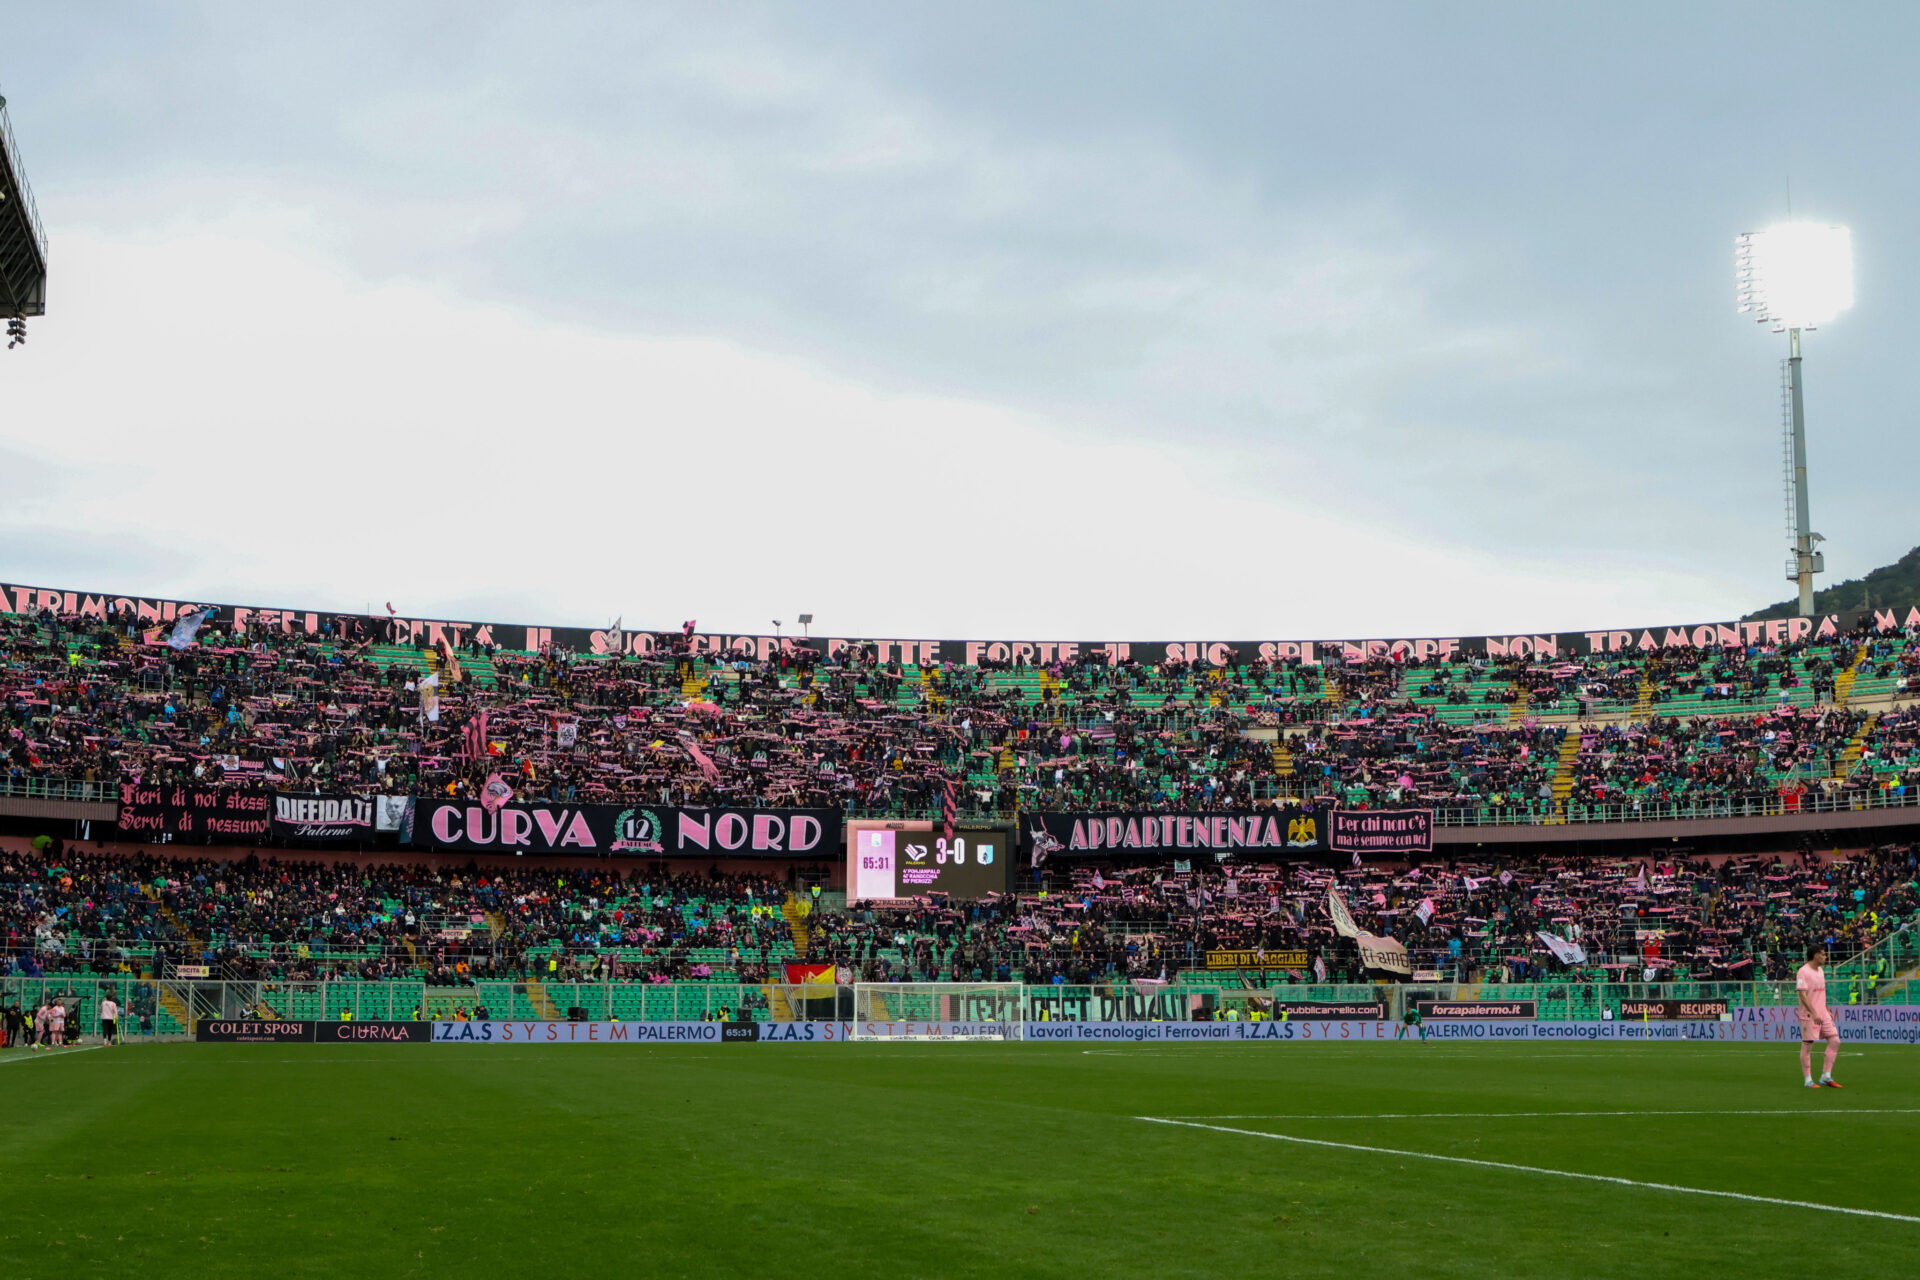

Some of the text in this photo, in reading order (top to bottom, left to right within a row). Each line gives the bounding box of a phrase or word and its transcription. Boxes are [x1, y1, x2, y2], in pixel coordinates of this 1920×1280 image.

[828, 639, 940, 665] BTTE
[1258, 638, 1459, 666] SPLNDORE
[1486, 634, 1557, 660] NON
[119, 783, 161, 805] Fieri
[171, 785, 186, 807] di
[226, 792, 268, 811] stessi
[276, 795, 372, 824] DIFFIDATI
[118, 806, 267, 834] Servi di nessuno
[431, 805, 597, 848] CURVA
[678, 811, 822, 851] NORD
[1338, 816, 1359, 832] Per
[1361, 816, 1380, 832] chi
[1383, 819, 1406, 832] non
[294, 824, 353, 838] Palermo
[625, 819, 650, 839] 12
[1069, 815, 1282, 850] APPARTENENZA
[1337, 833, 1427, 847] ma è sempre con noi
[863, 856, 889, 870] 65:31
[1206, 953, 1238, 965] LIBERI
[1240, 953, 1250, 965] DI
[1377, 951, 1409, 968] amo
[1432, 1004, 1521, 1016] forzapalermo.it
[1621, 1003, 1726, 1014] PALERMO RECUPERI
[1845, 1009, 1892, 1021] PALERMO
[209, 1022, 303, 1035] COLET SPOSI
[337, 1025, 409, 1040] CIURMA
[502, 1023, 628, 1040] SYSTEM
[638, 1025, 716, 1040] PALERMO
[726, 1028, 752, 1037] 65:31
[1030, 1022, 1073, 1038] Lavori
[1078, 1023, 1161, 1041] Tecnologici
[1165, 1022, 1230, 1038] Ferroviari
[1489, 1023, 1529, 1037] Lavori
[1532, 1022, 1614, 1040] Tecnologici
[1619, 1023, 1678, 1037] Ferroviari
[1719, 1023, 1786, 1039] SYSTEM
[1839, 1026, 1867, 1039] Lavori
